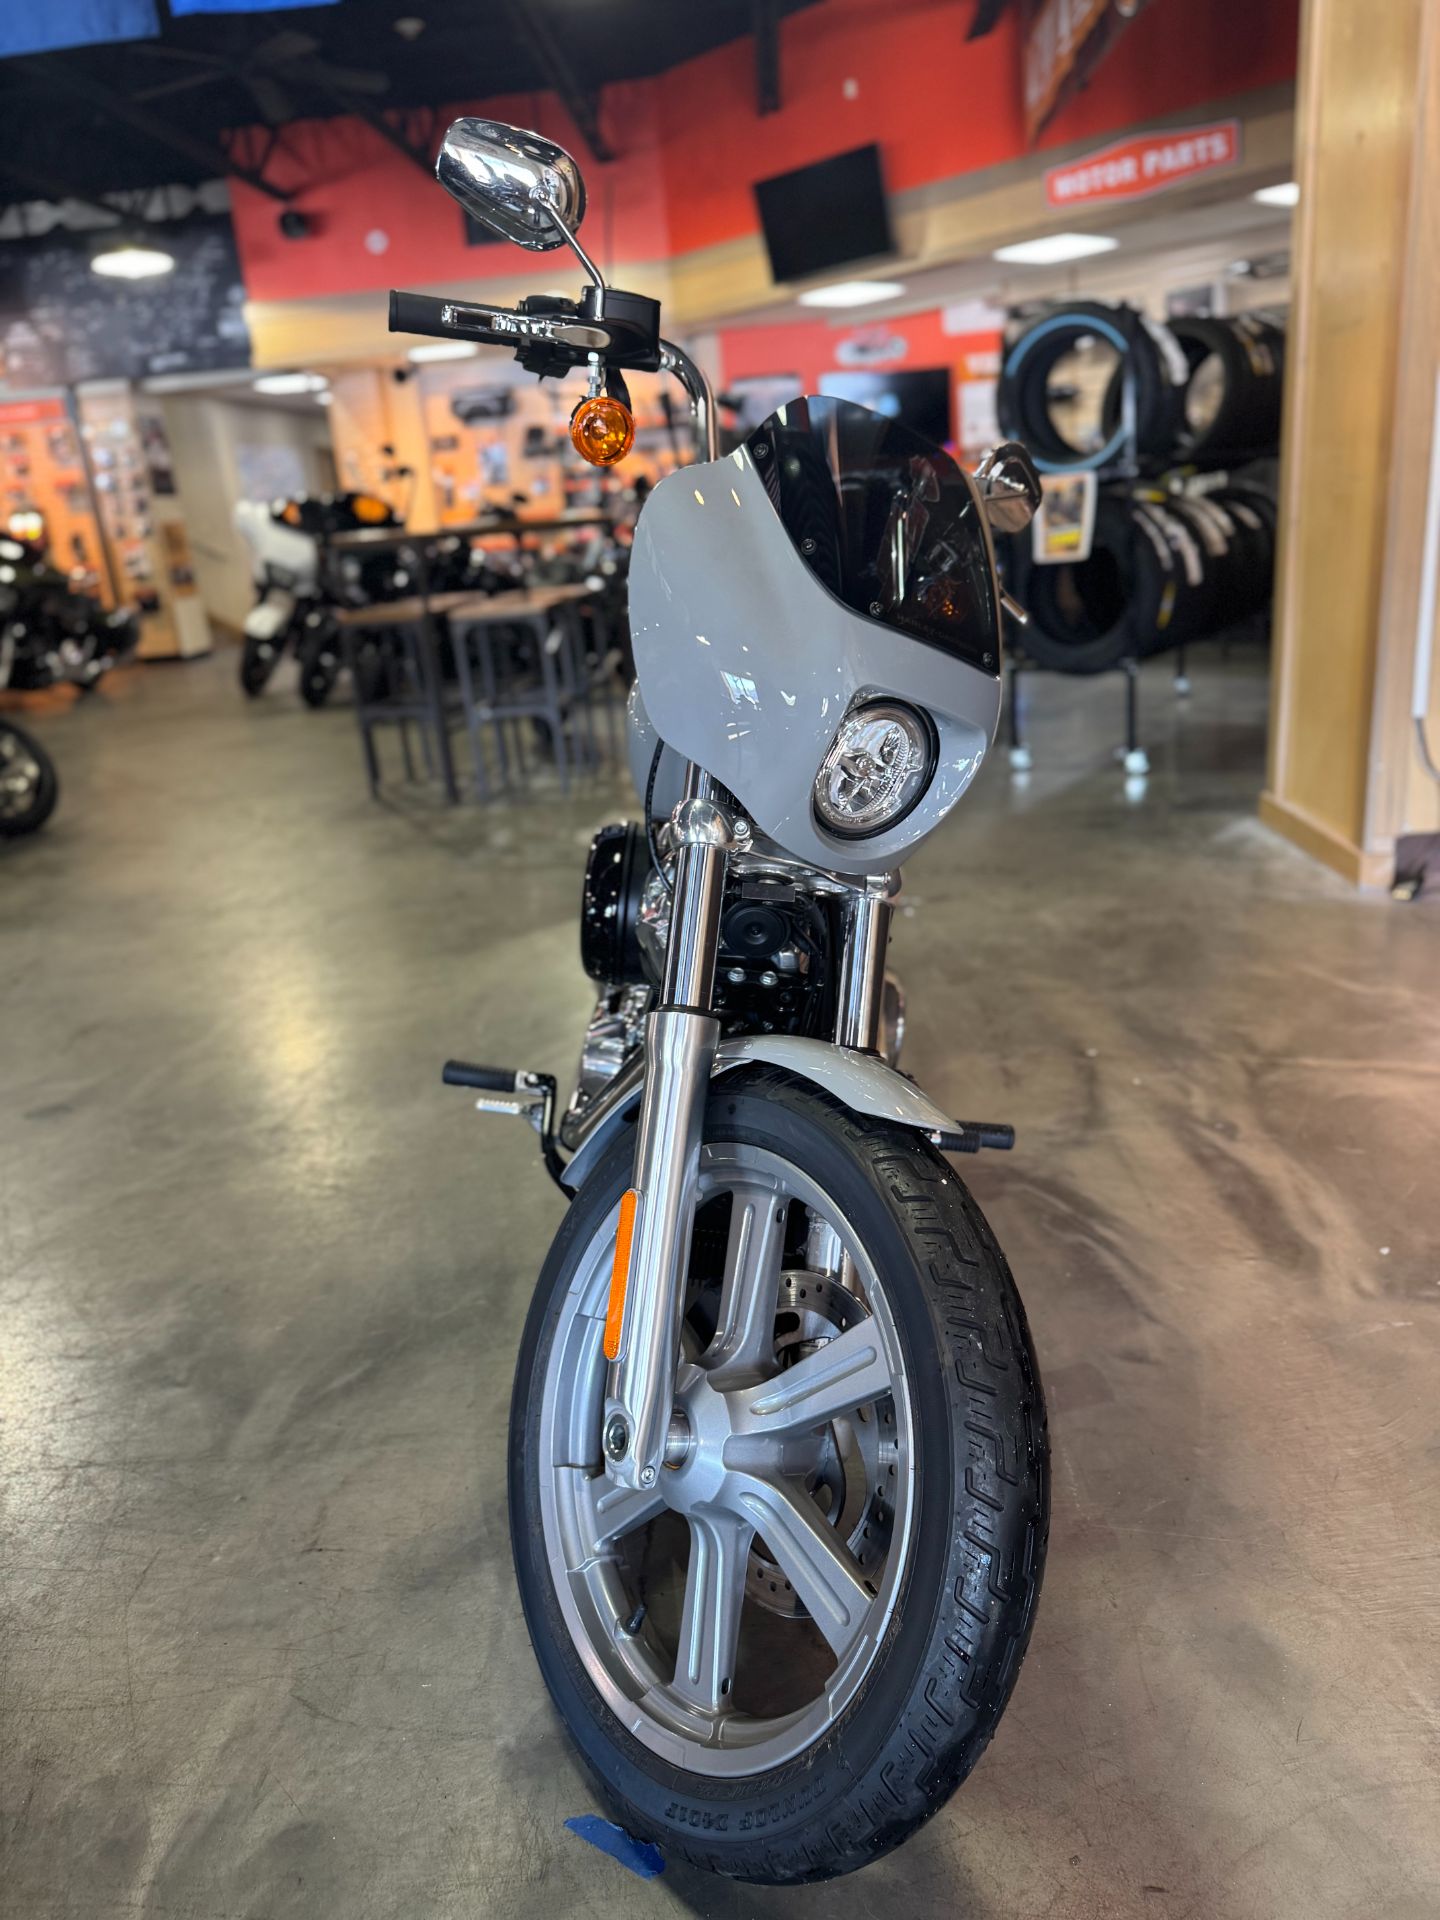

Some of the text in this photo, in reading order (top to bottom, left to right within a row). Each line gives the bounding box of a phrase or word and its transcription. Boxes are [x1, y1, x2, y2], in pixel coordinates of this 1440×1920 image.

[1054, 132, 1227, 197] MOTOR PARTS
[739, 1775, 828, 1831] DUNLOP
